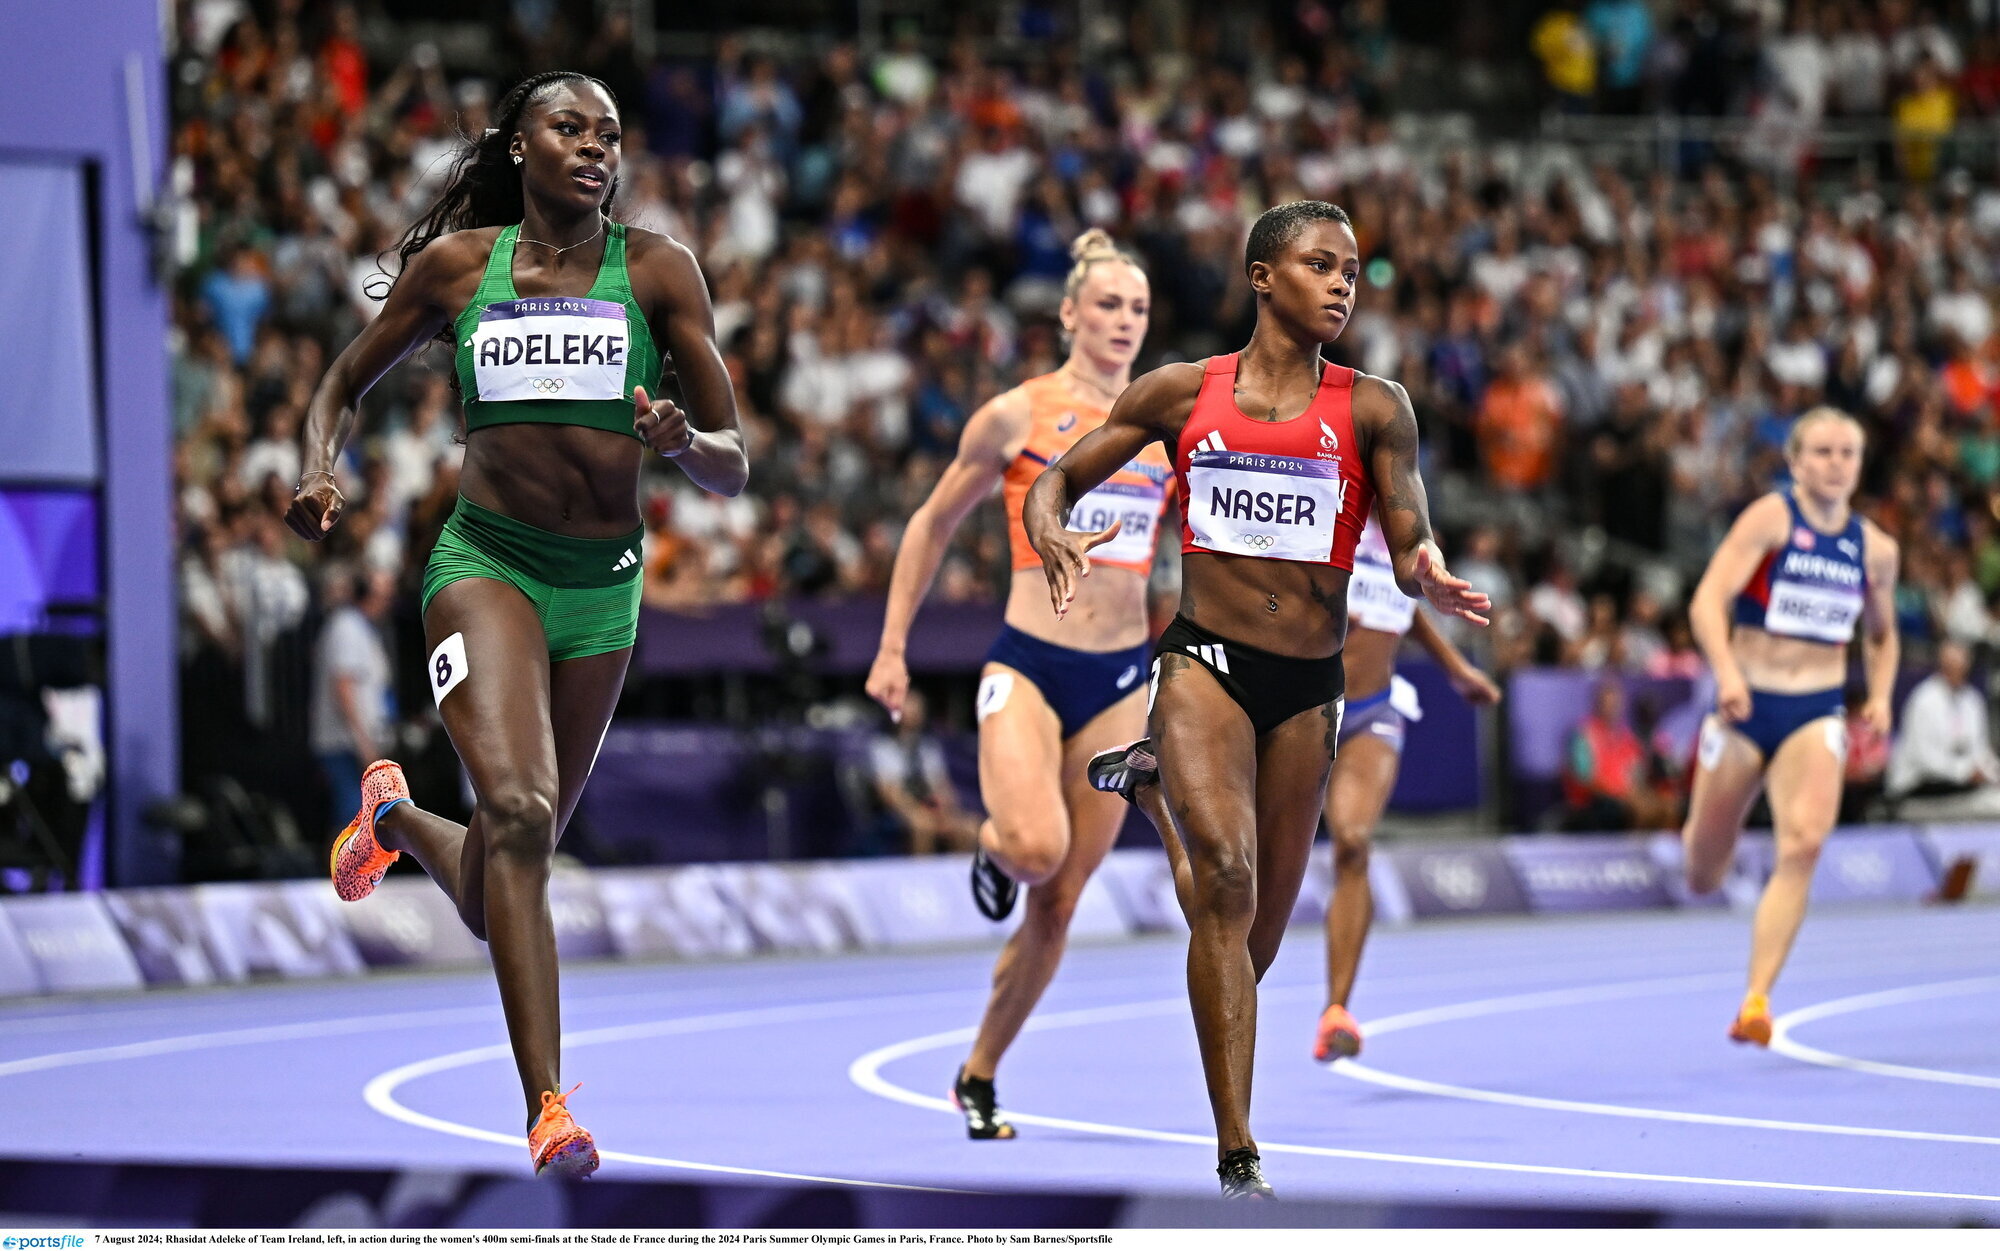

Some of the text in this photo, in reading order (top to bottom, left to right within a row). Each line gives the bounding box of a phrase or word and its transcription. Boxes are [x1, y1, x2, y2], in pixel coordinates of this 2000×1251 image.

[554, 302, 588, 312] 2024
[480, 334, 624, 367] ADELEKE
[1270, 460, 1303, 471] 2024
[1210, 486, 1316, 526] NASER
[1784, 551, 1862, 586] NORWAY
[436, 653, 453, 688] 8
